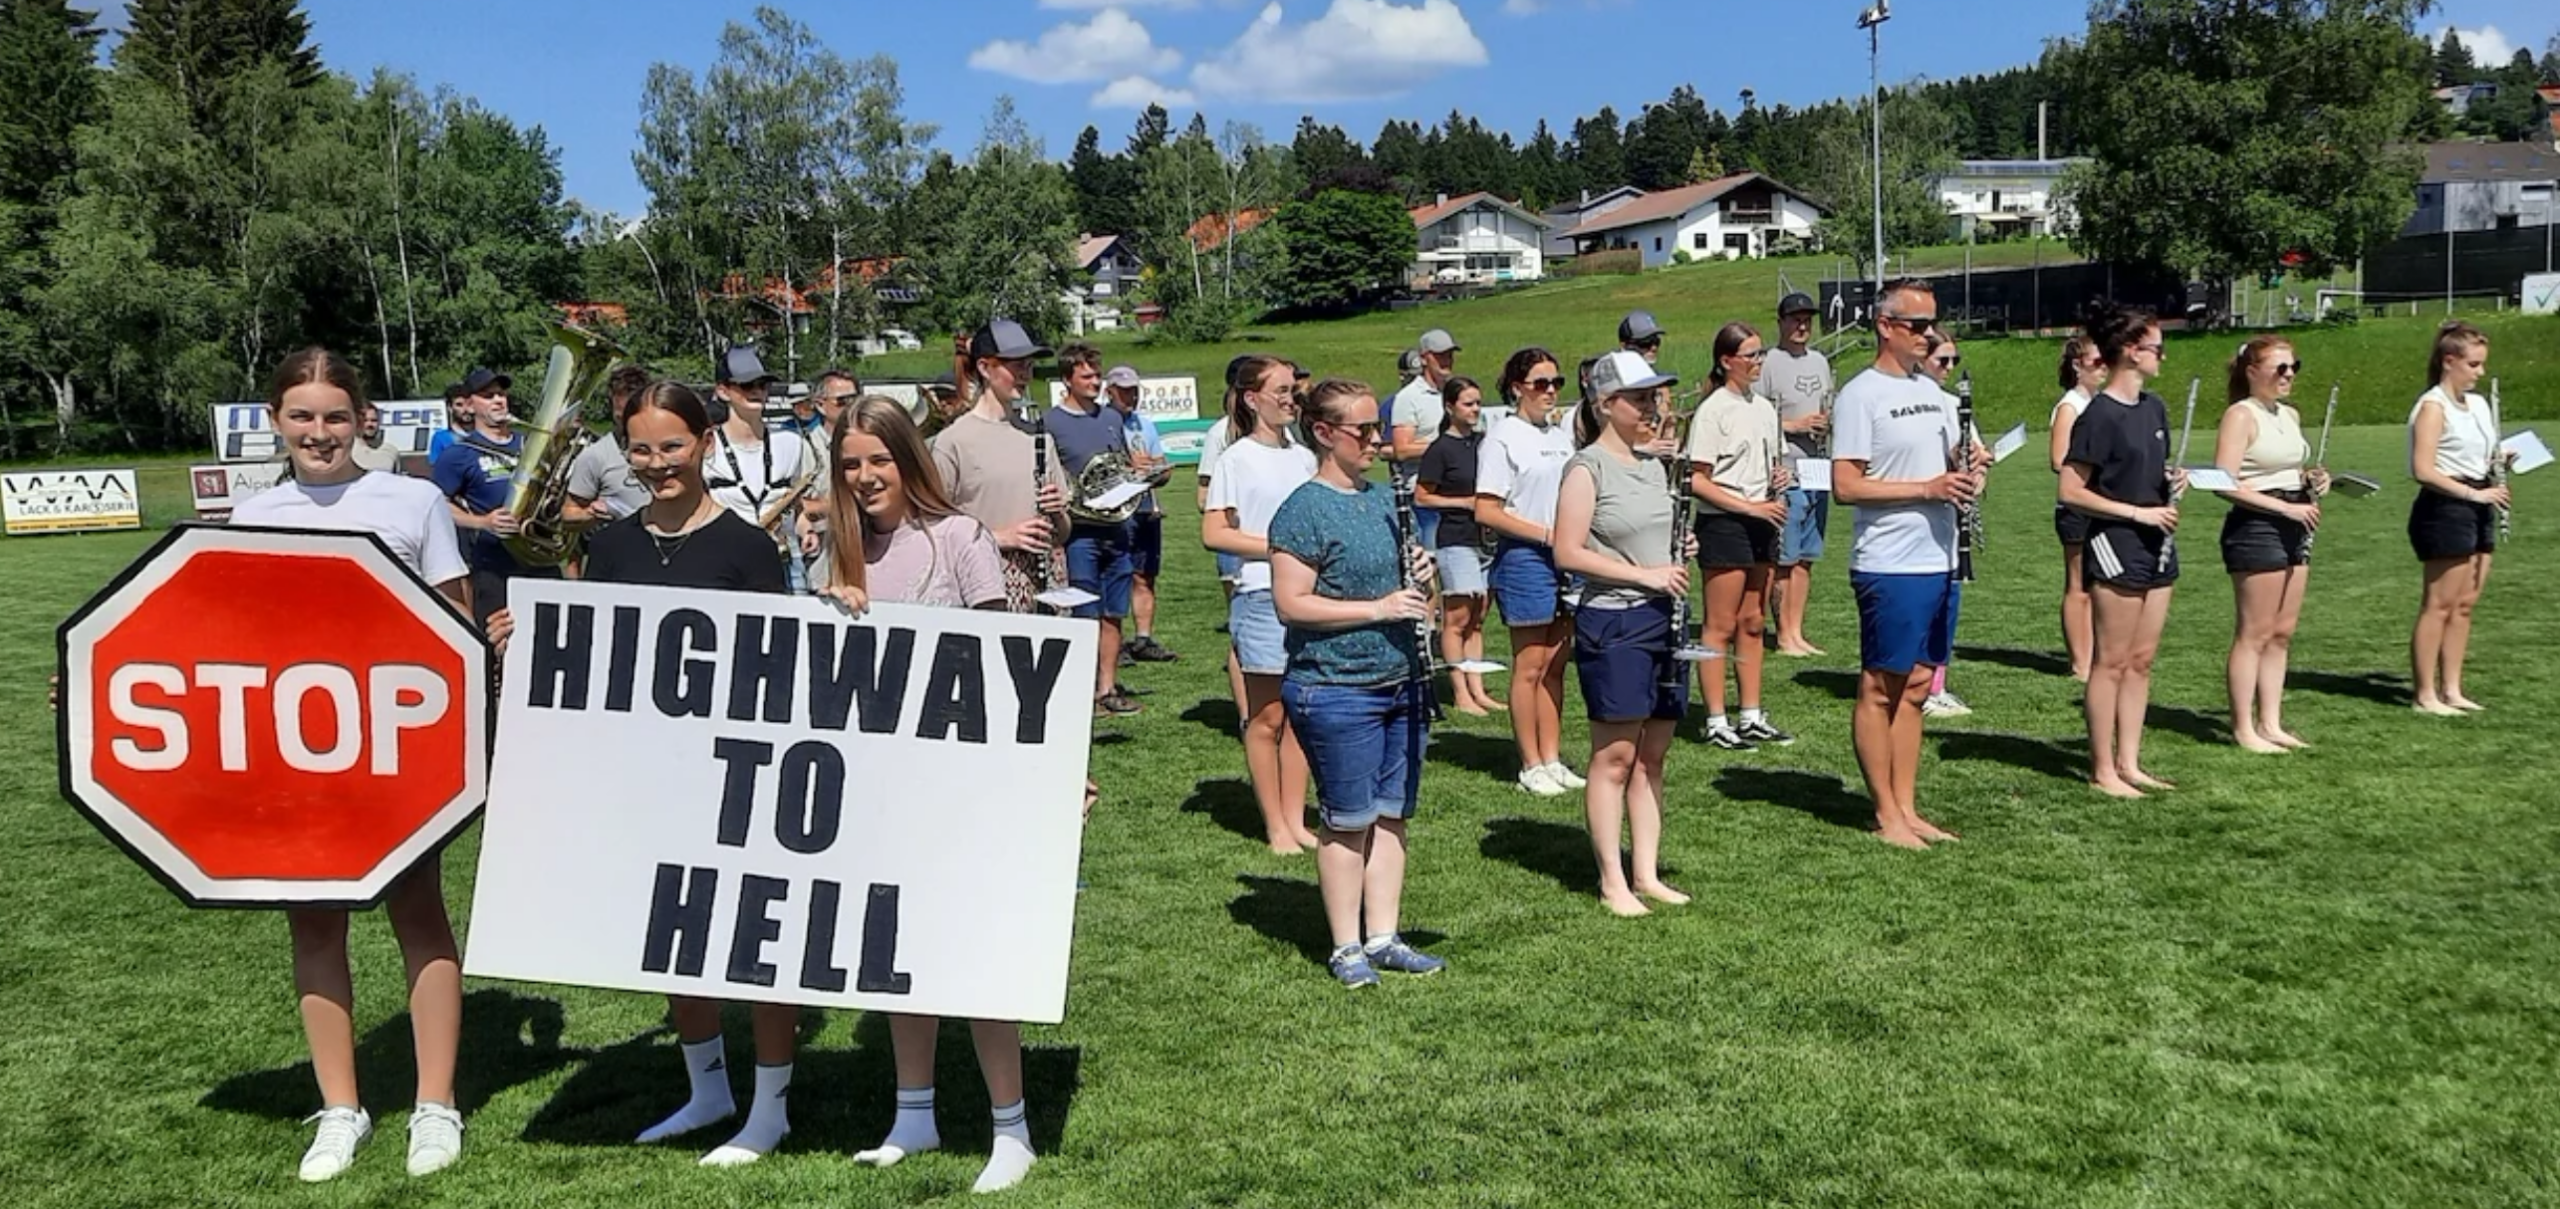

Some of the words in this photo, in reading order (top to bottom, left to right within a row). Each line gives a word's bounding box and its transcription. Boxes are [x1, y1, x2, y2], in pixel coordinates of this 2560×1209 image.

[20, 504, 52, 515] LACK
[108, 662, 450, 776] STOP
[527, 602, 1071, 744] HIGHWAY
[713, 736, 846, 854] TO
[641, 862, 912, 995] HELL
